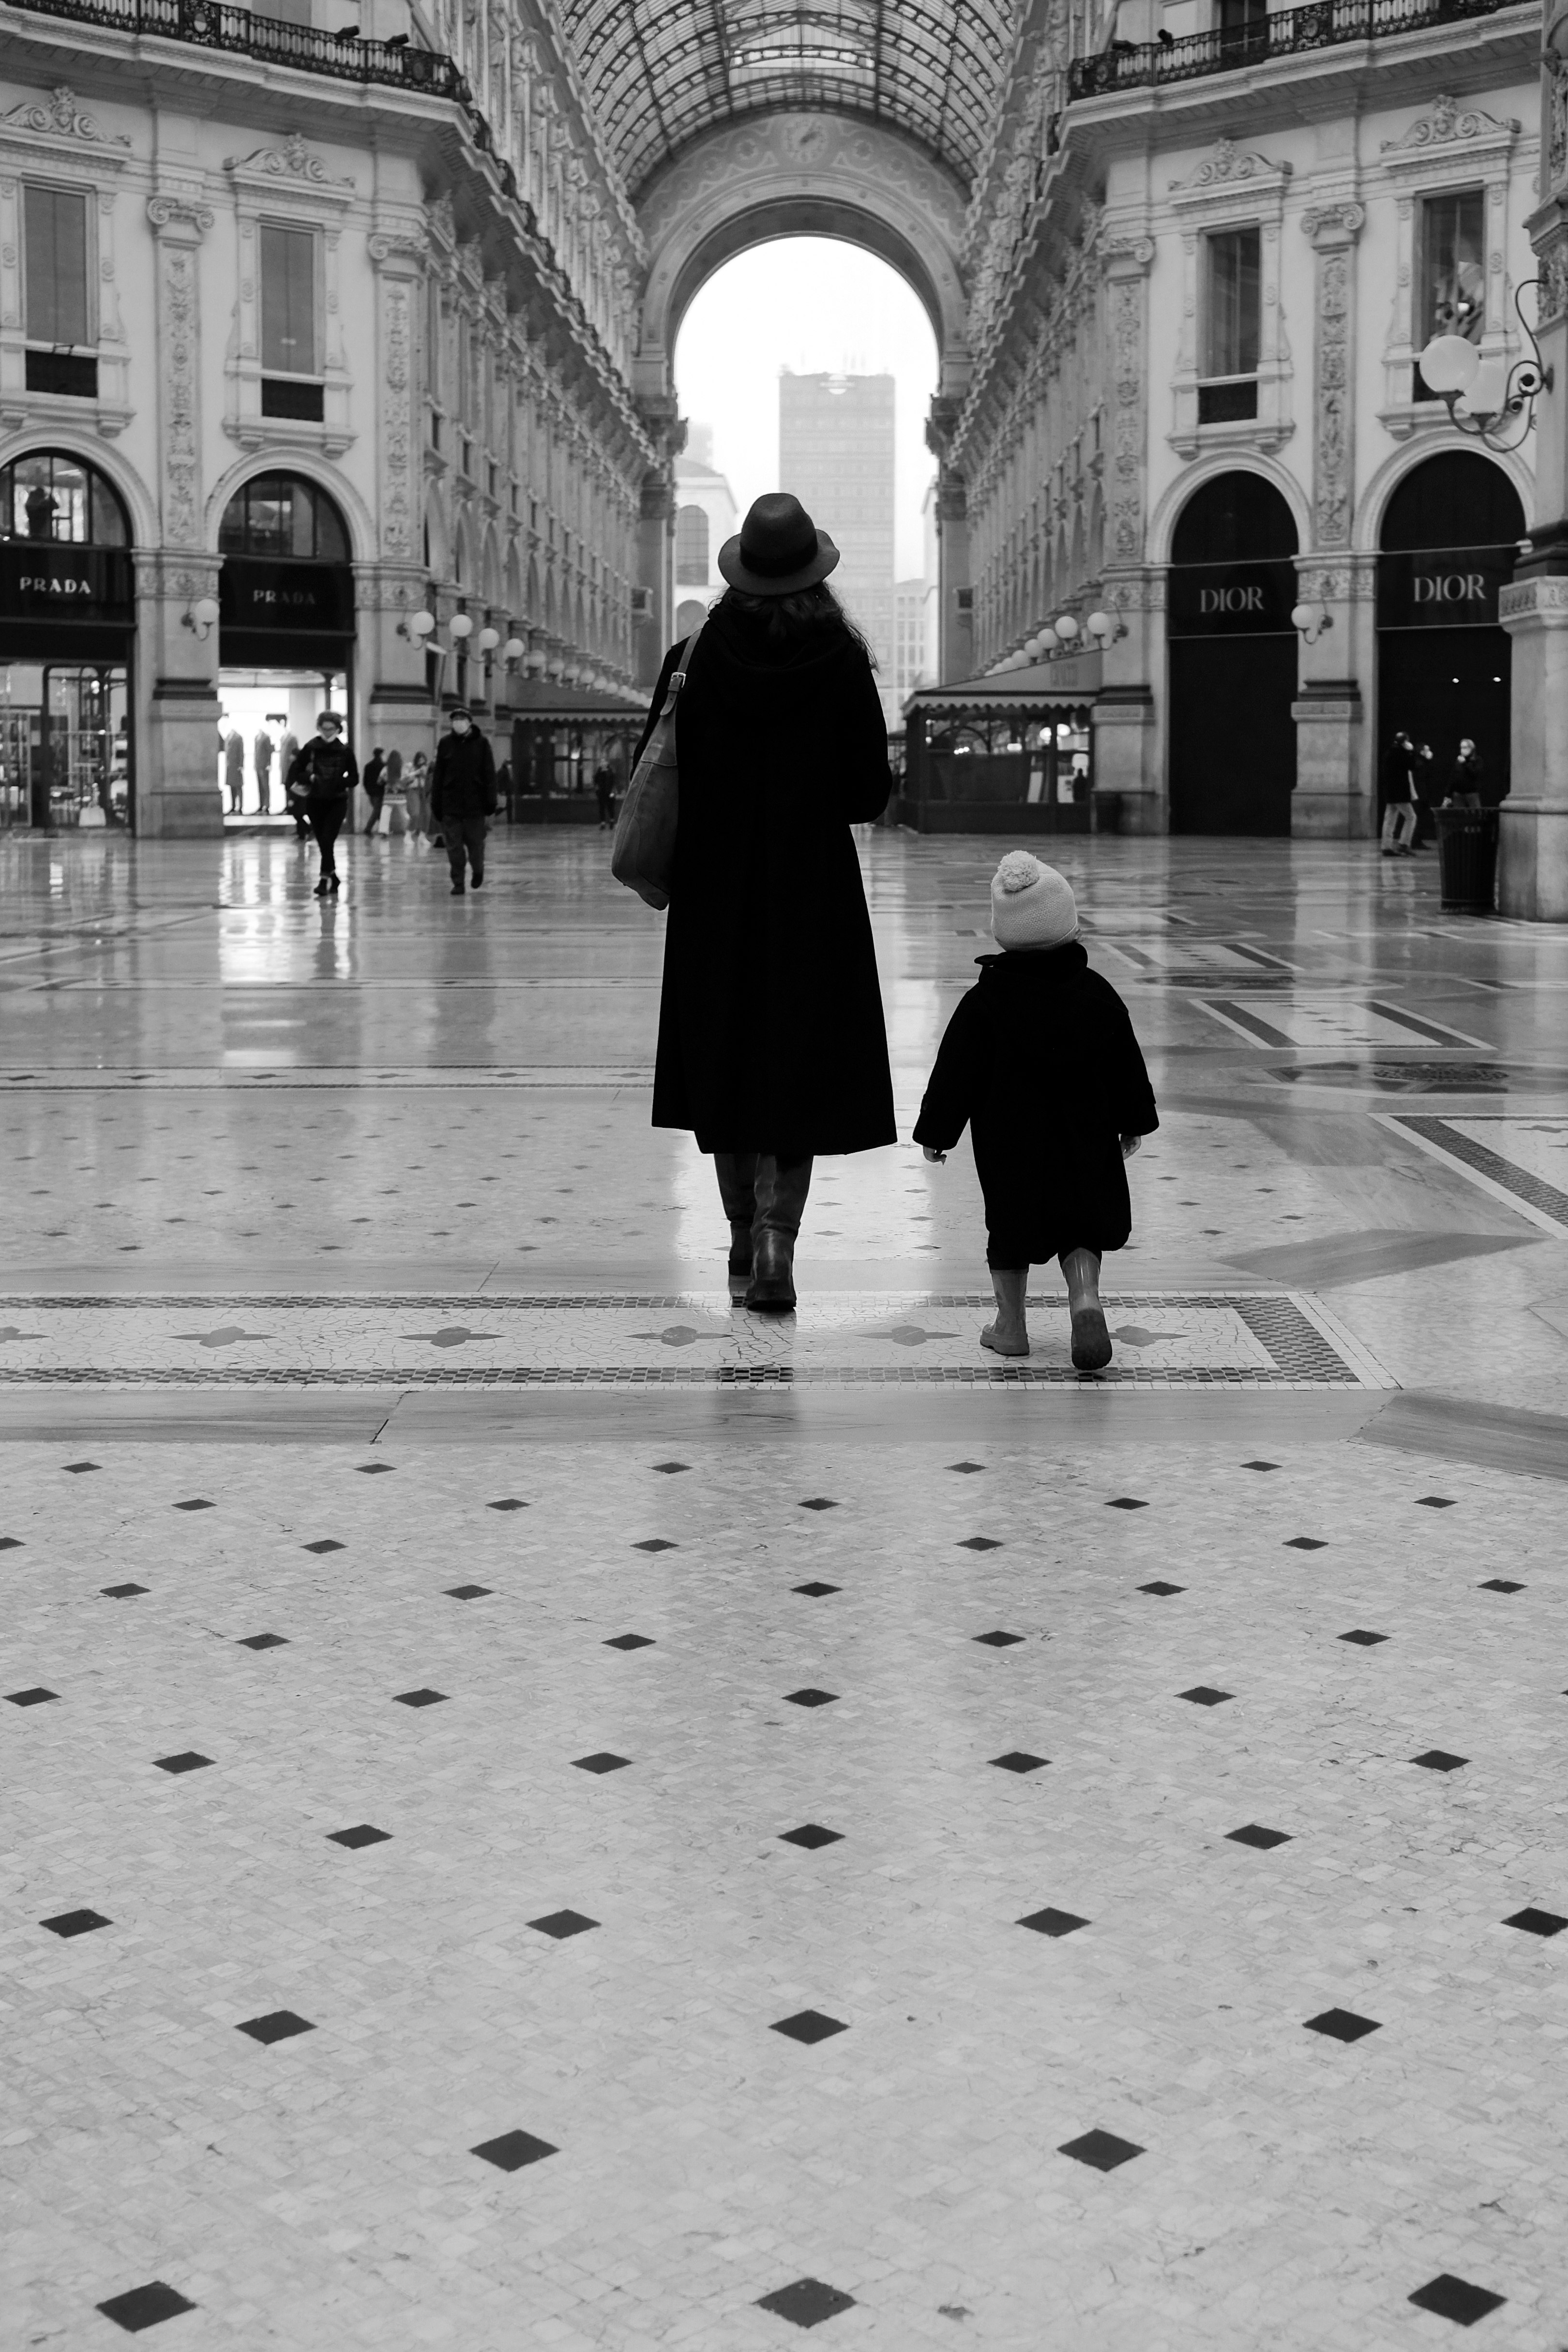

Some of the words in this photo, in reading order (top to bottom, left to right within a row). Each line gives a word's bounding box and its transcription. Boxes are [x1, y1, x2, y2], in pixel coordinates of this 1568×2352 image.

[20, 577, 90, 594] PRADA
[253, 589, 315, 603] PRADA
[1414, 574, 1486, 602] DIOR
[1200, 587, 1264, 612] DIOR
